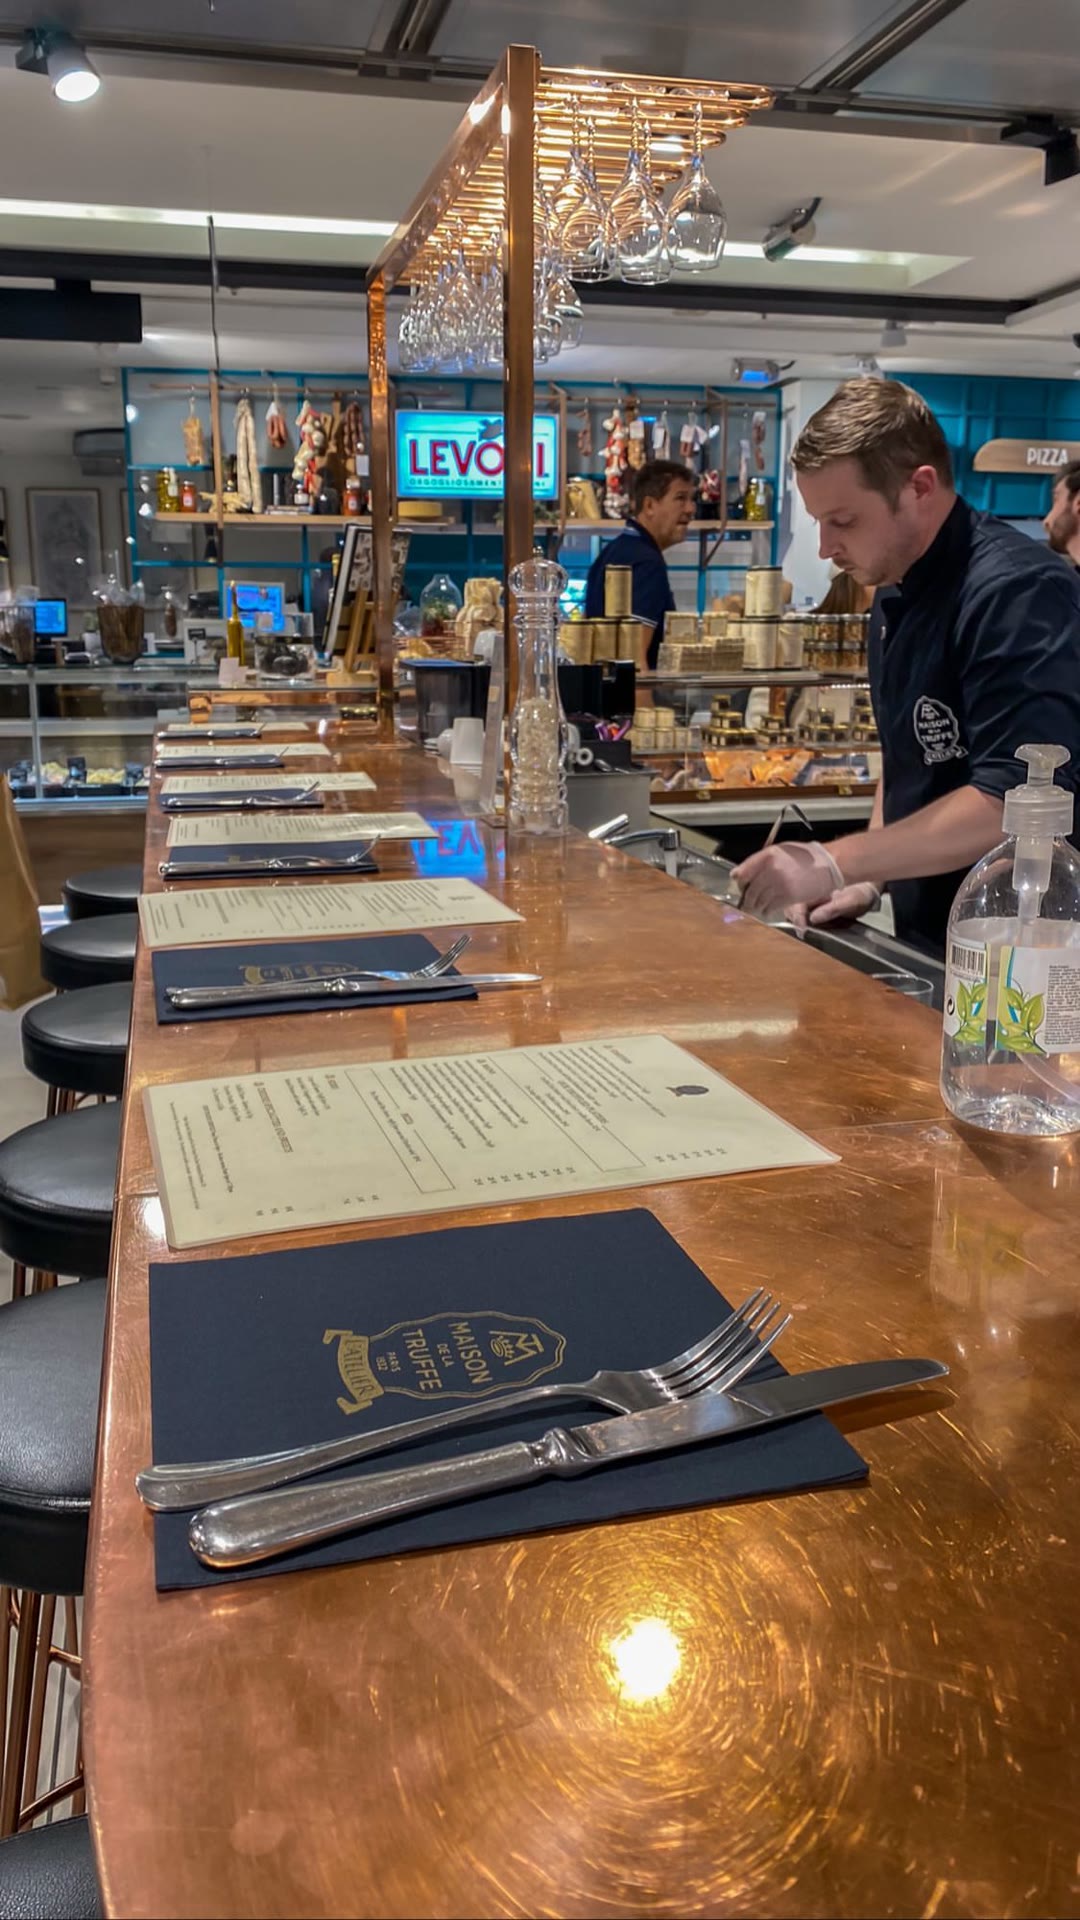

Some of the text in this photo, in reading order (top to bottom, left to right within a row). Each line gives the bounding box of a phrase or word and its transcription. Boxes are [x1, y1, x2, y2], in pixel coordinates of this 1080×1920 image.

[409, 439, 544, 477] LEVOI
[1026, 447, 1068, 466] PIZZA
[402, 1328, 443, 1391] TRUFFE
[437, 1343, 455, 1368] DE LA
[448, 1322, 493, 1384] MAISON
